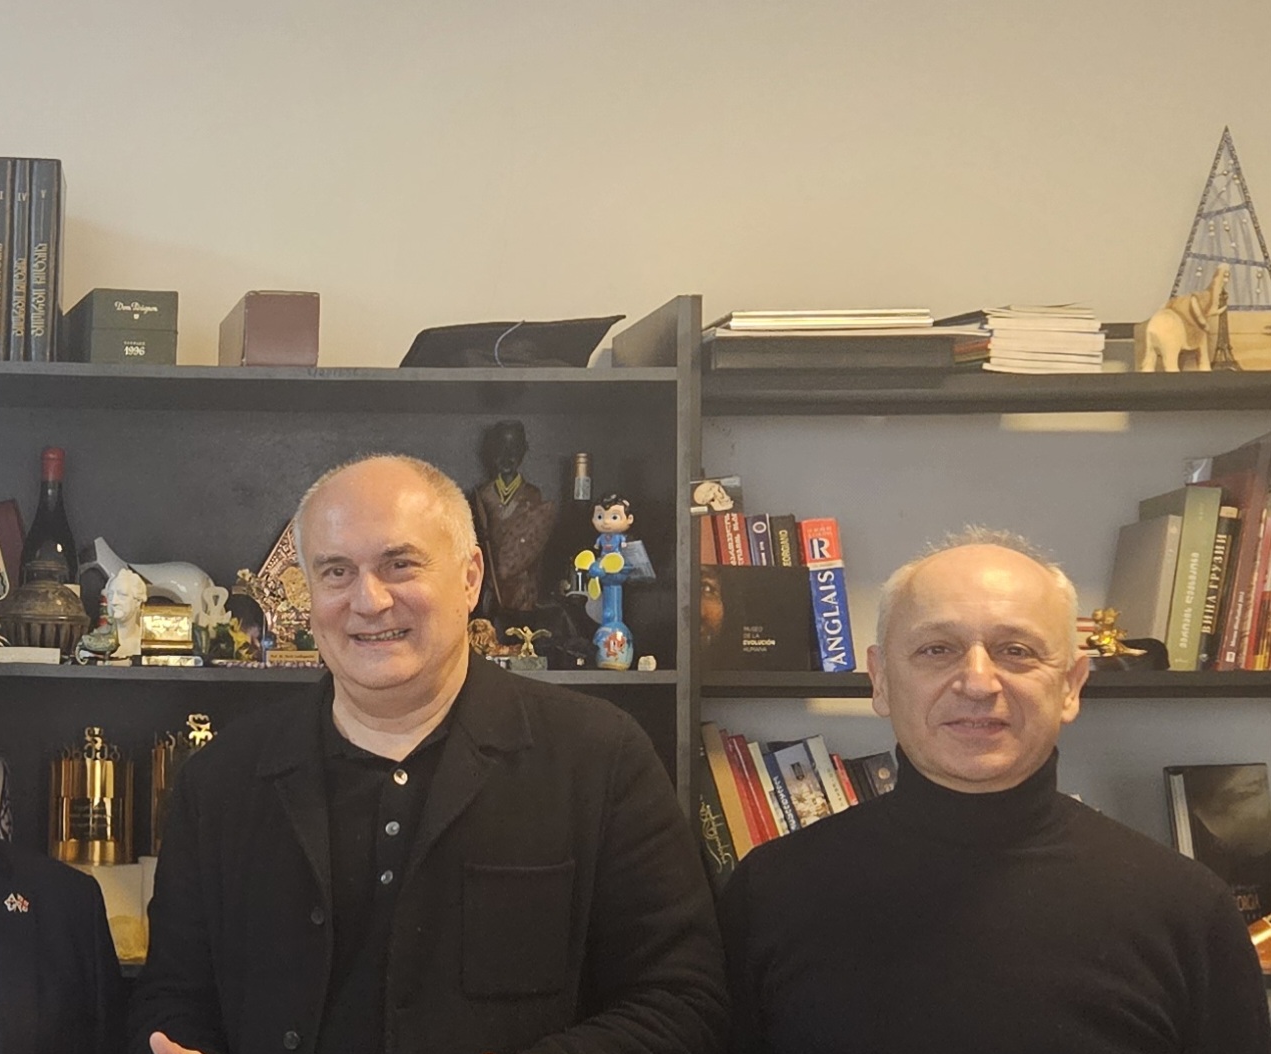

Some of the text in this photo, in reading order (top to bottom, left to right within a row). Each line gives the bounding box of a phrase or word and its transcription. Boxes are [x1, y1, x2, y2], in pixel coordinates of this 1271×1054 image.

[124, 346, 145, 356] 1996
[778, 529, 792, 567] EORGIANO
[810, 538, 831, 560] R
[1202, 533, 1227, 633] ВИНА ГРУЗИИ
[817, 570, 847, 666] ANGLAIS
[742, 638, 776, 646] EVOLUCIÓN
